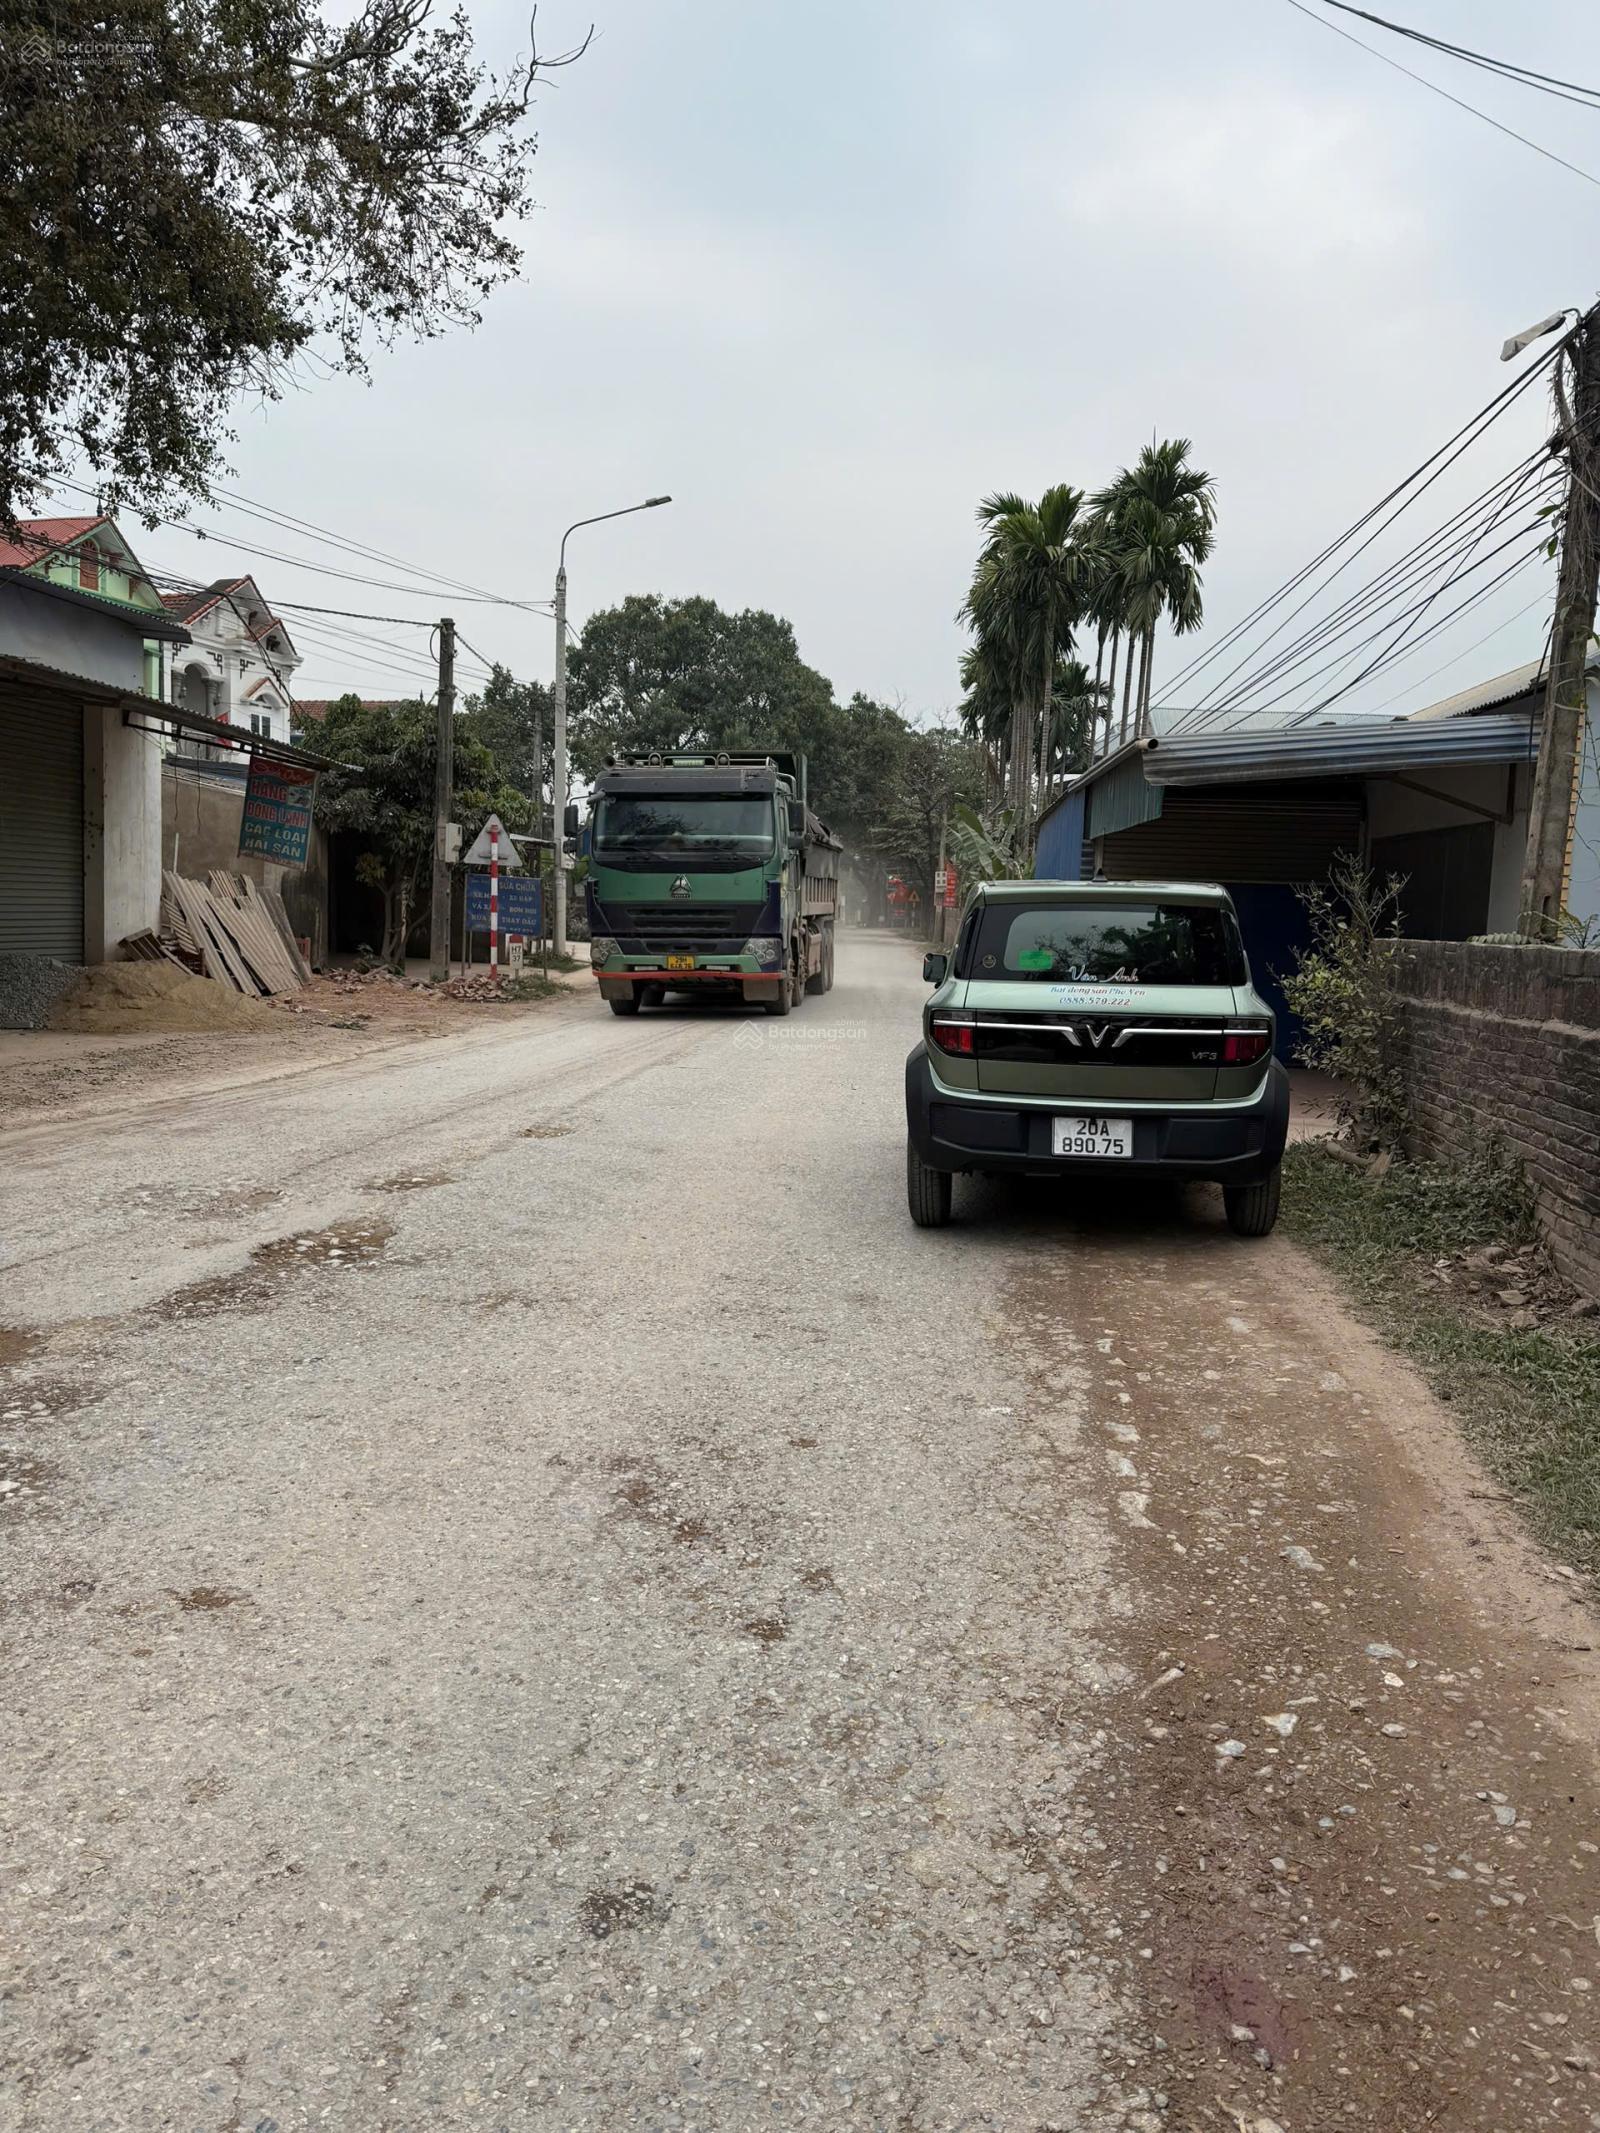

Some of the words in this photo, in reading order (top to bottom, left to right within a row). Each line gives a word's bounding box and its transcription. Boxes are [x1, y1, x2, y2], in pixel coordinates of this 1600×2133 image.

[1099, 966, 1139, 982] Anh
[1192, 1051, 1216, 1060] VF3
[1077, 1120, 1110, 1136] 20A
[1062, 1137, 1124, 1154] 890.75
